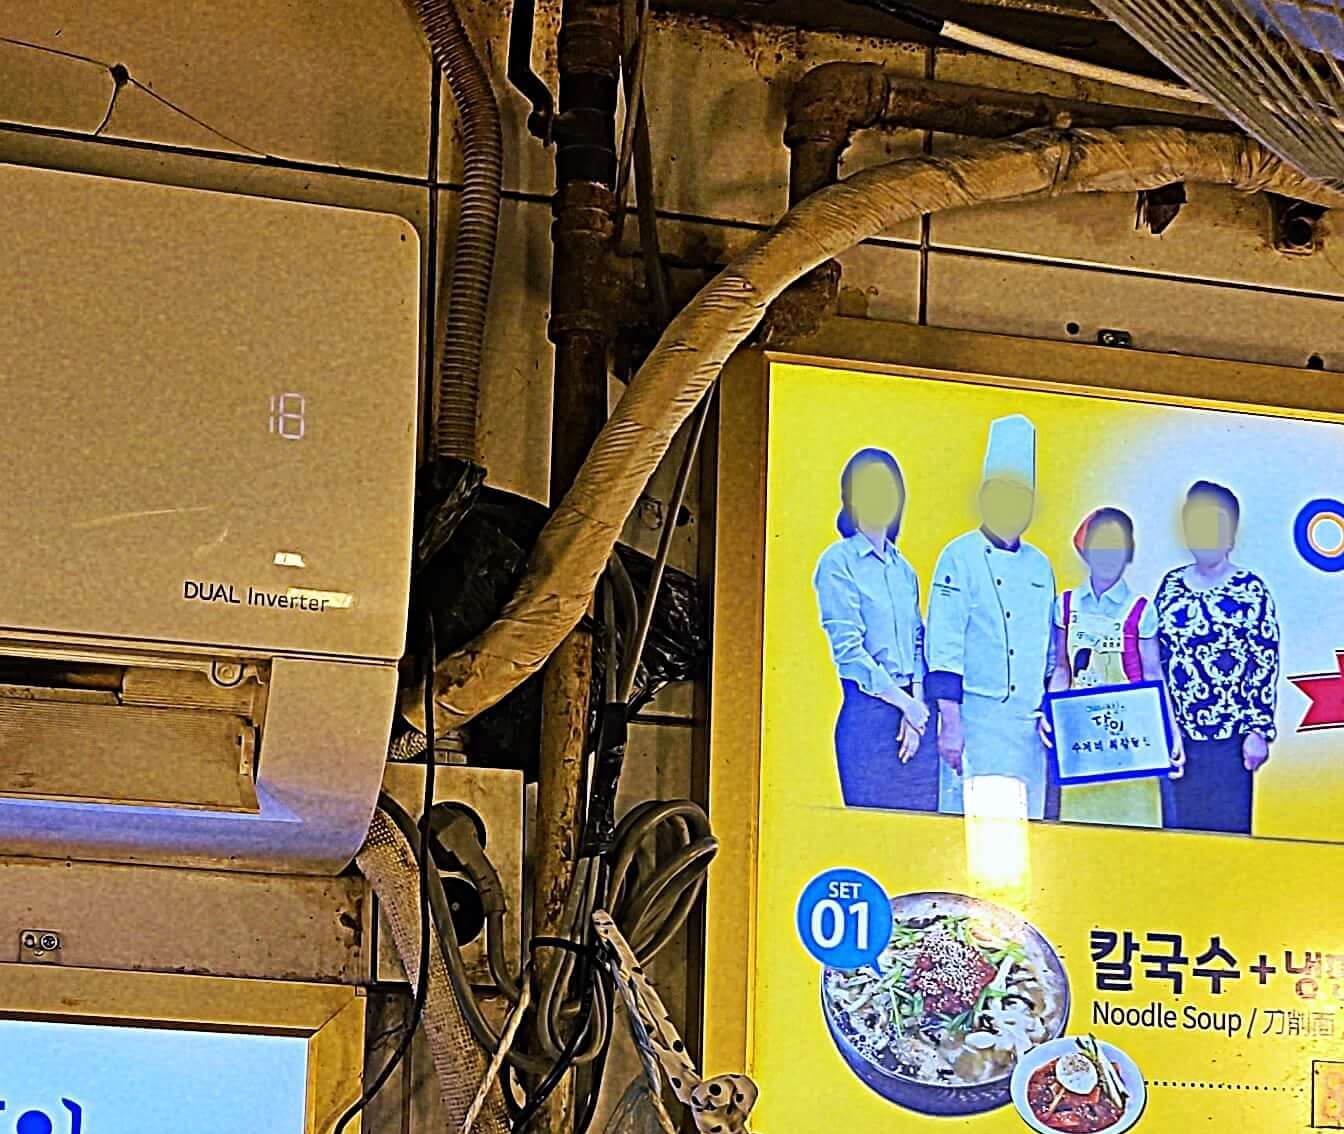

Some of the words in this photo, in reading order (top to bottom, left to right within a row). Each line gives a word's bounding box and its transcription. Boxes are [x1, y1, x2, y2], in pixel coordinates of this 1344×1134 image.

[268, 392, 305, 440] 18
[184, 581, 241, 604] DUAL
[248, 587, 331, 612] Inverter
[829, 881, 863, 900] SET
[810, 900, 874, 951] 01
[1092, 1001, 1178, 1029] Noodle
[1182, 1006, 1243, 1038] Soup
